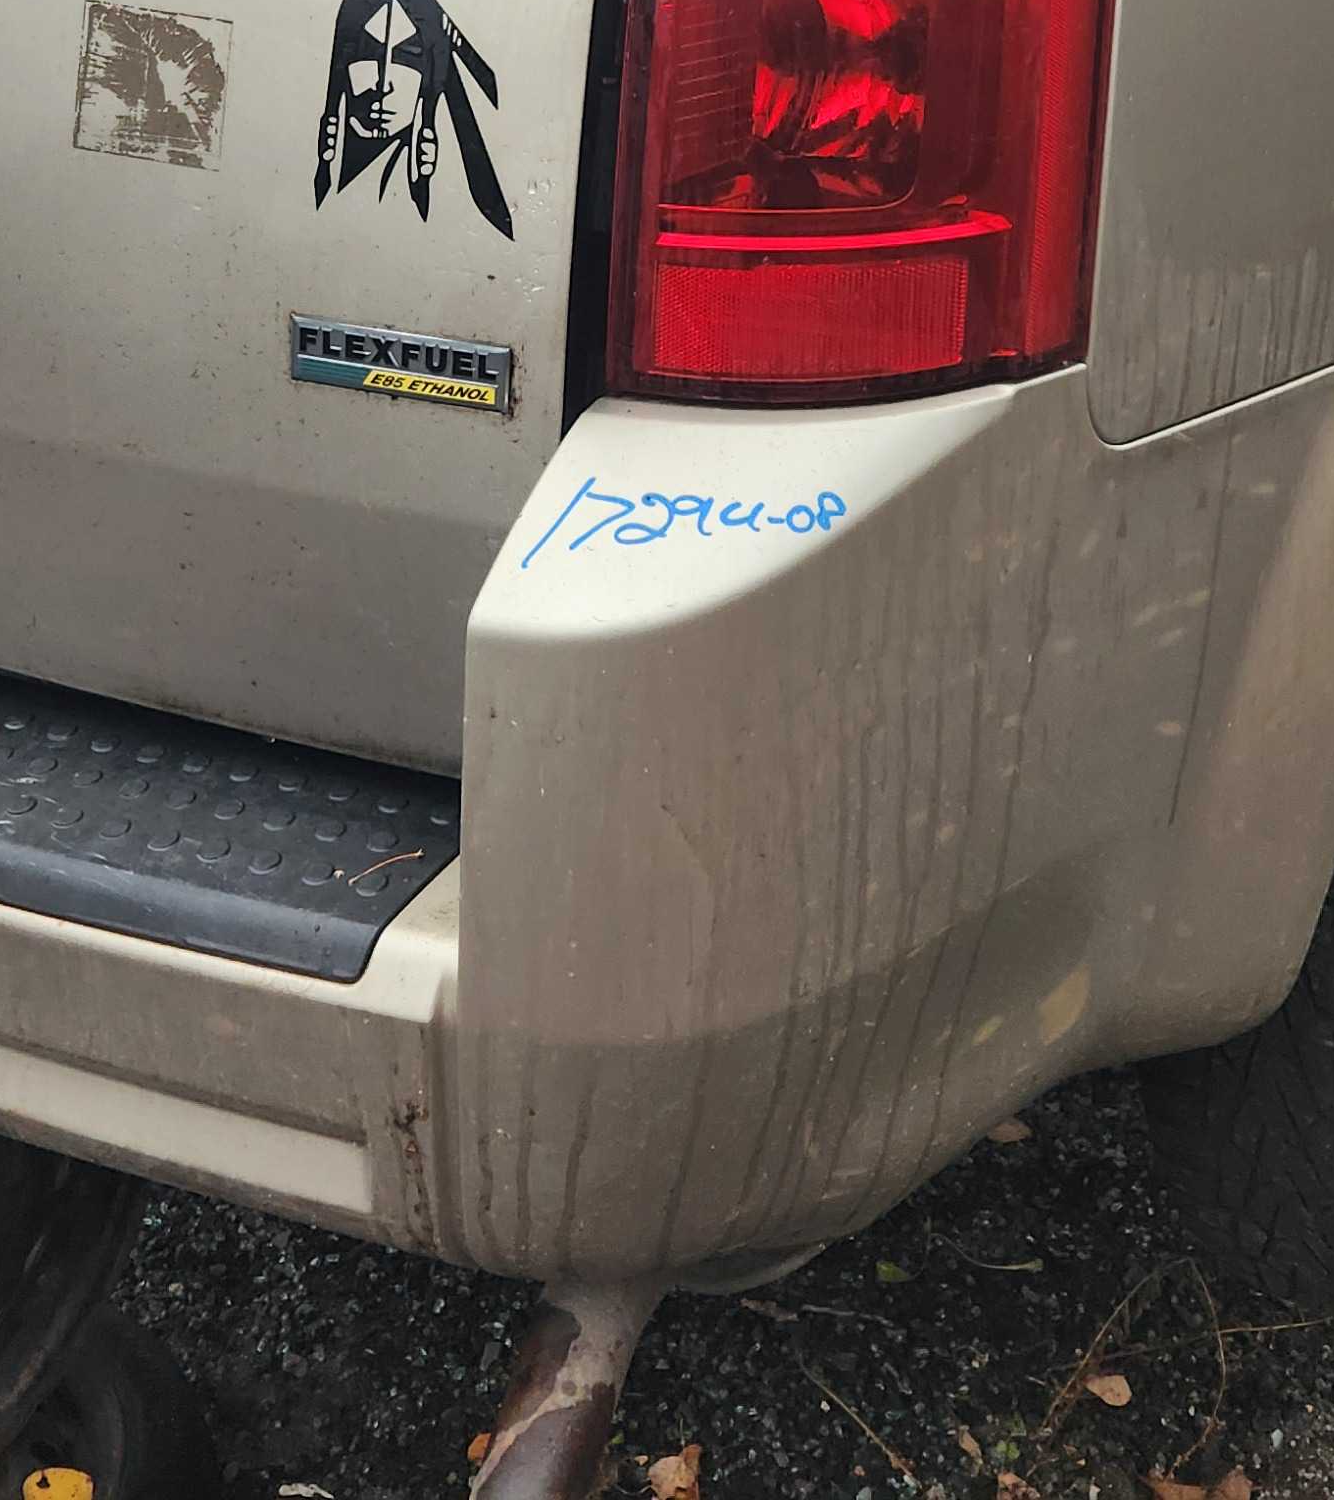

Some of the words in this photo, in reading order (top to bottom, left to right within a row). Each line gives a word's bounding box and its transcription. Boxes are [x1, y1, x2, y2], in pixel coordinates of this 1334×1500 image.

[298, 326, 500, 380] FLEXFUEL
[371, 374, 405, 390] E85
[408, 381, 491, 402] ETHANOL
[521, 477, 847, 569] 17294-08
